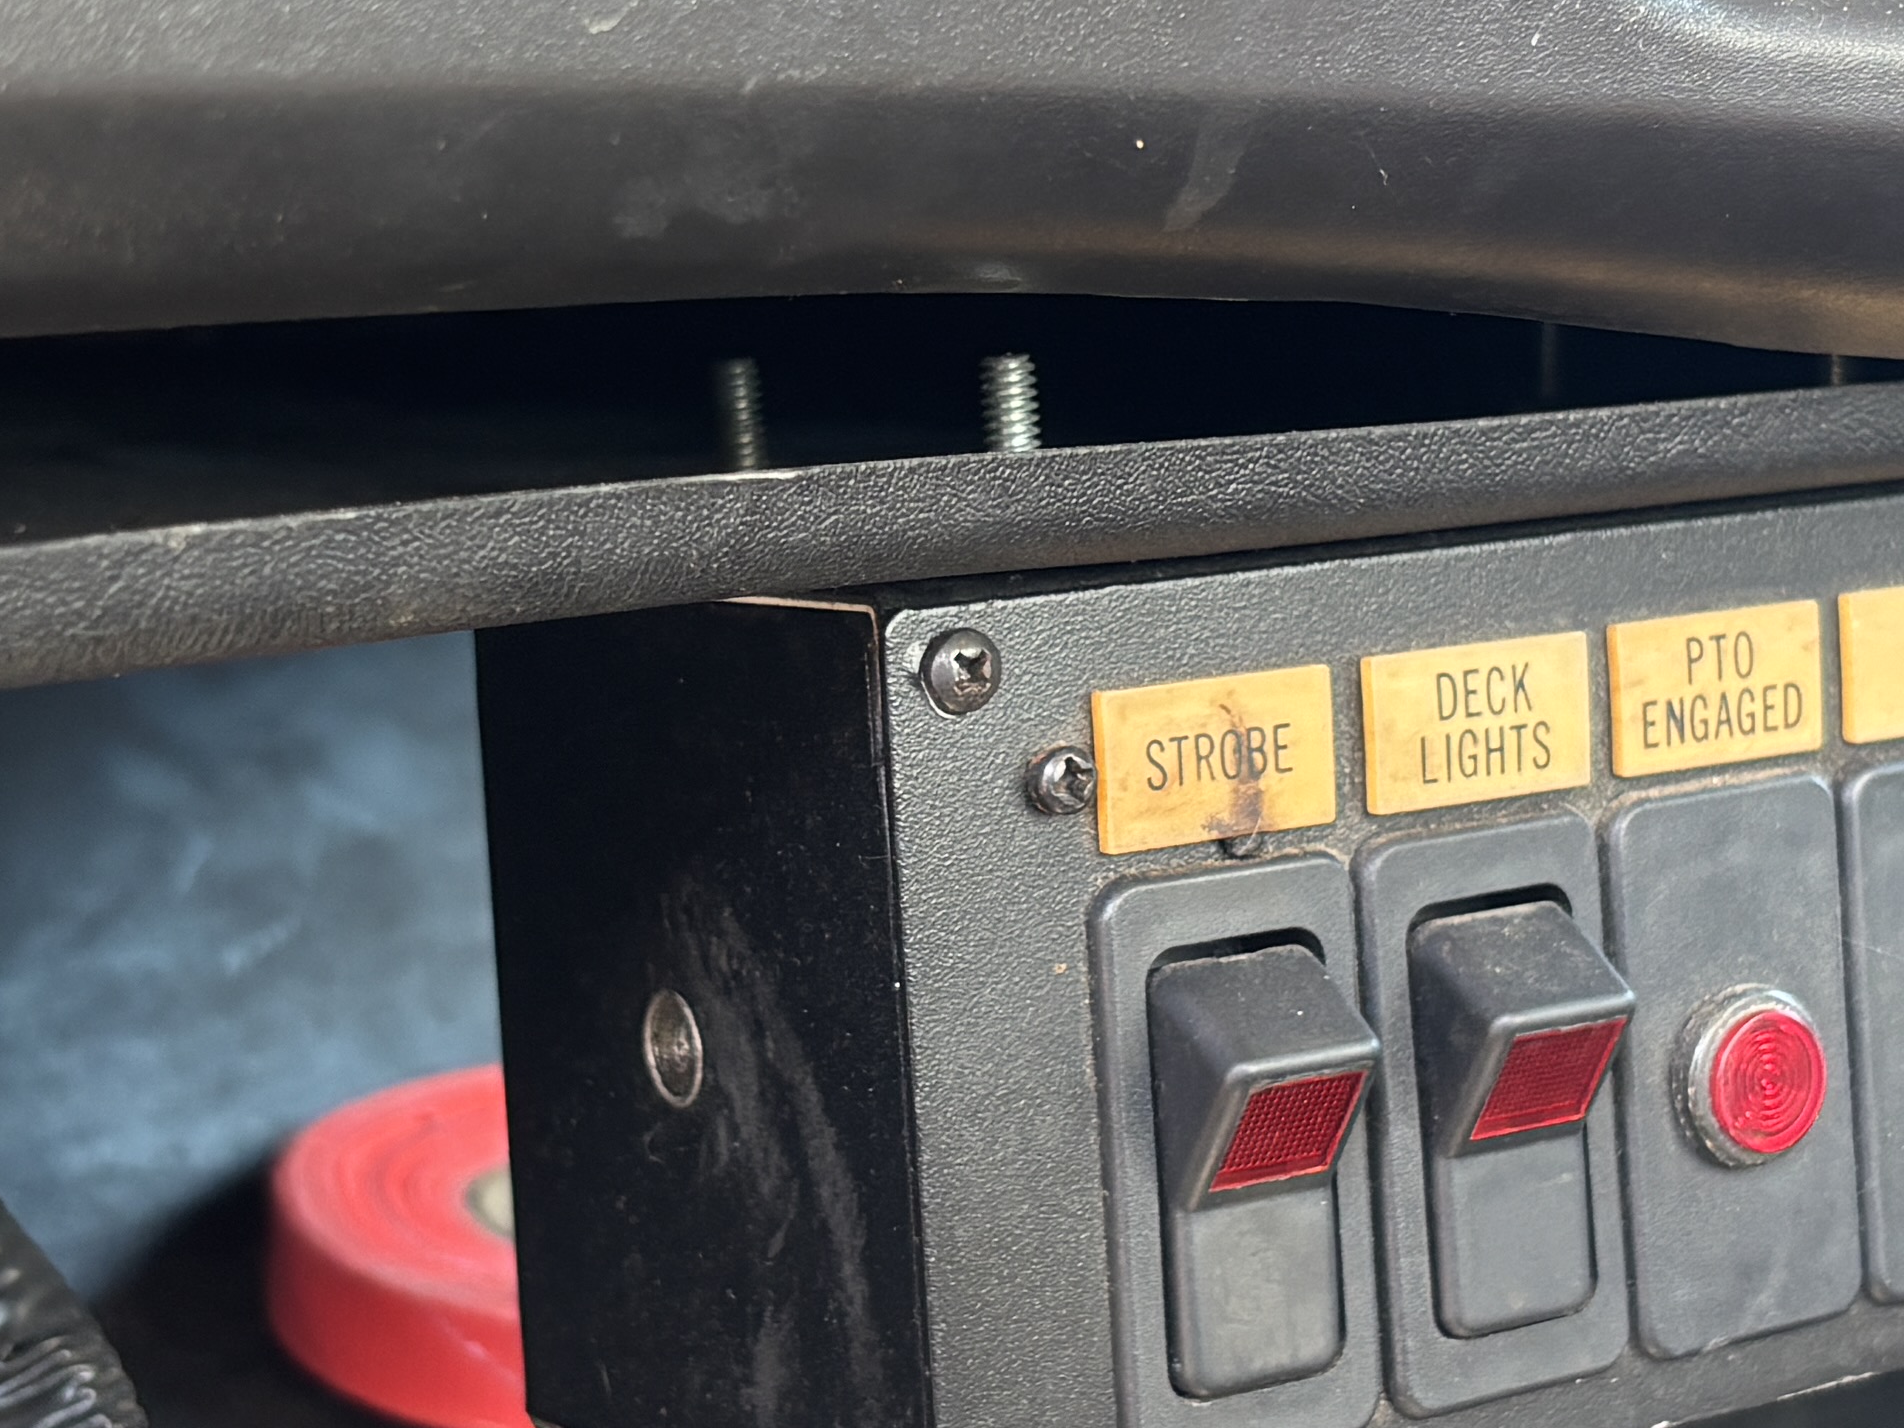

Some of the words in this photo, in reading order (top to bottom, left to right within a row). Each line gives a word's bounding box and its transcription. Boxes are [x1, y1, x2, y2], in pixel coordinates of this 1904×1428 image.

[1686, 630, 1754, 686] PTO
[1436, 661, 1533, 722] DECK
[1642, 682, 1803, 749] ENGAGED
[1145, 722, 1293, 792] STROBE
[1419, 719, 1552, 785] LIGHTS
